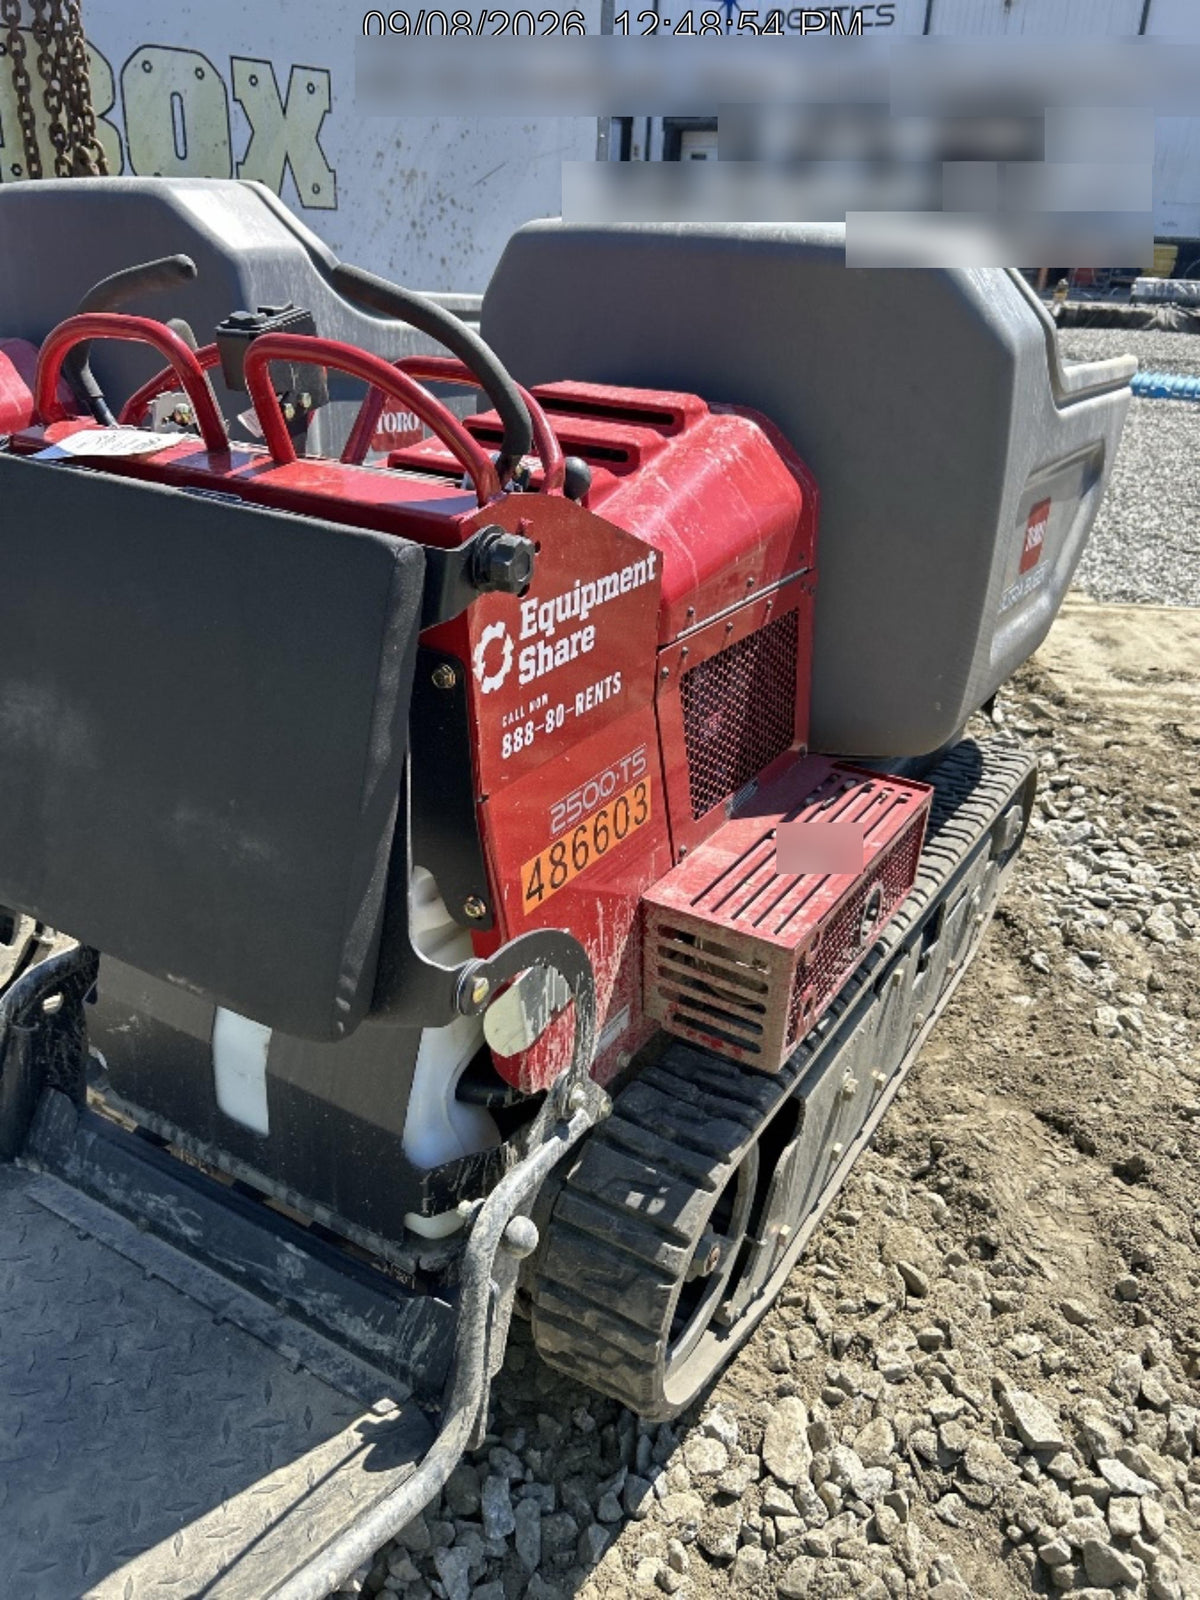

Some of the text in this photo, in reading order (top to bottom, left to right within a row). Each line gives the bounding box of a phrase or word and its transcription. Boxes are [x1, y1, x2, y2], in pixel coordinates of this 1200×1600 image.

[376, 411, 420, 434] TORO
[520, 550, 657, 640] Equipment
[518, 625, 596, 685] Share
[502, 672, 622, 760] 888-80-RENTS
[503, 694, 548, 728] CALL NOW
[525, 782, 648, 902] 486603
